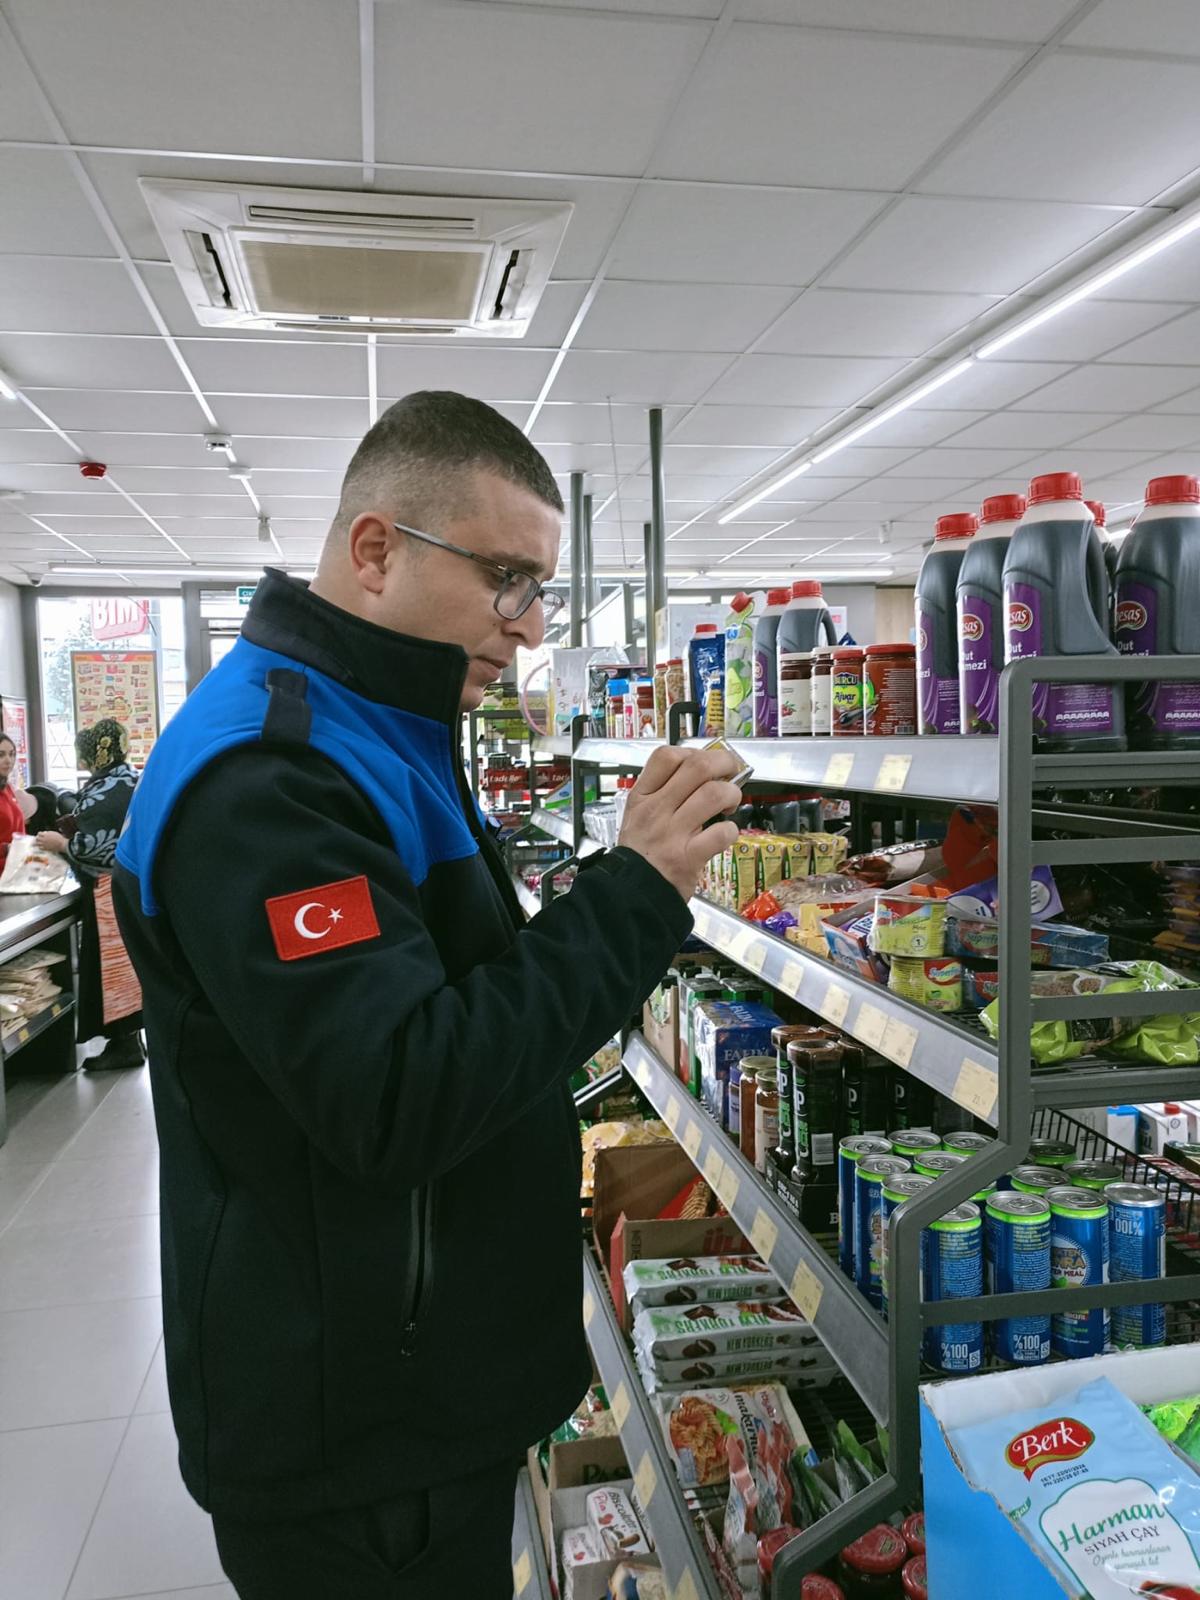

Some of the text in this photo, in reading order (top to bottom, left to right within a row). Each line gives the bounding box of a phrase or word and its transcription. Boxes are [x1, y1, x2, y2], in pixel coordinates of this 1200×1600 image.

[1115, 1218, 1144, 1236] %100
[941, 1342, 969, 1359] %100
[1013, 1334, 1041, 1351] %100
[1012, 1421, 1087, 1463] Berk
[1059, 1502, 1165, 1552] Harman
[1131, 1525, 1161, 1542] ÇAY
